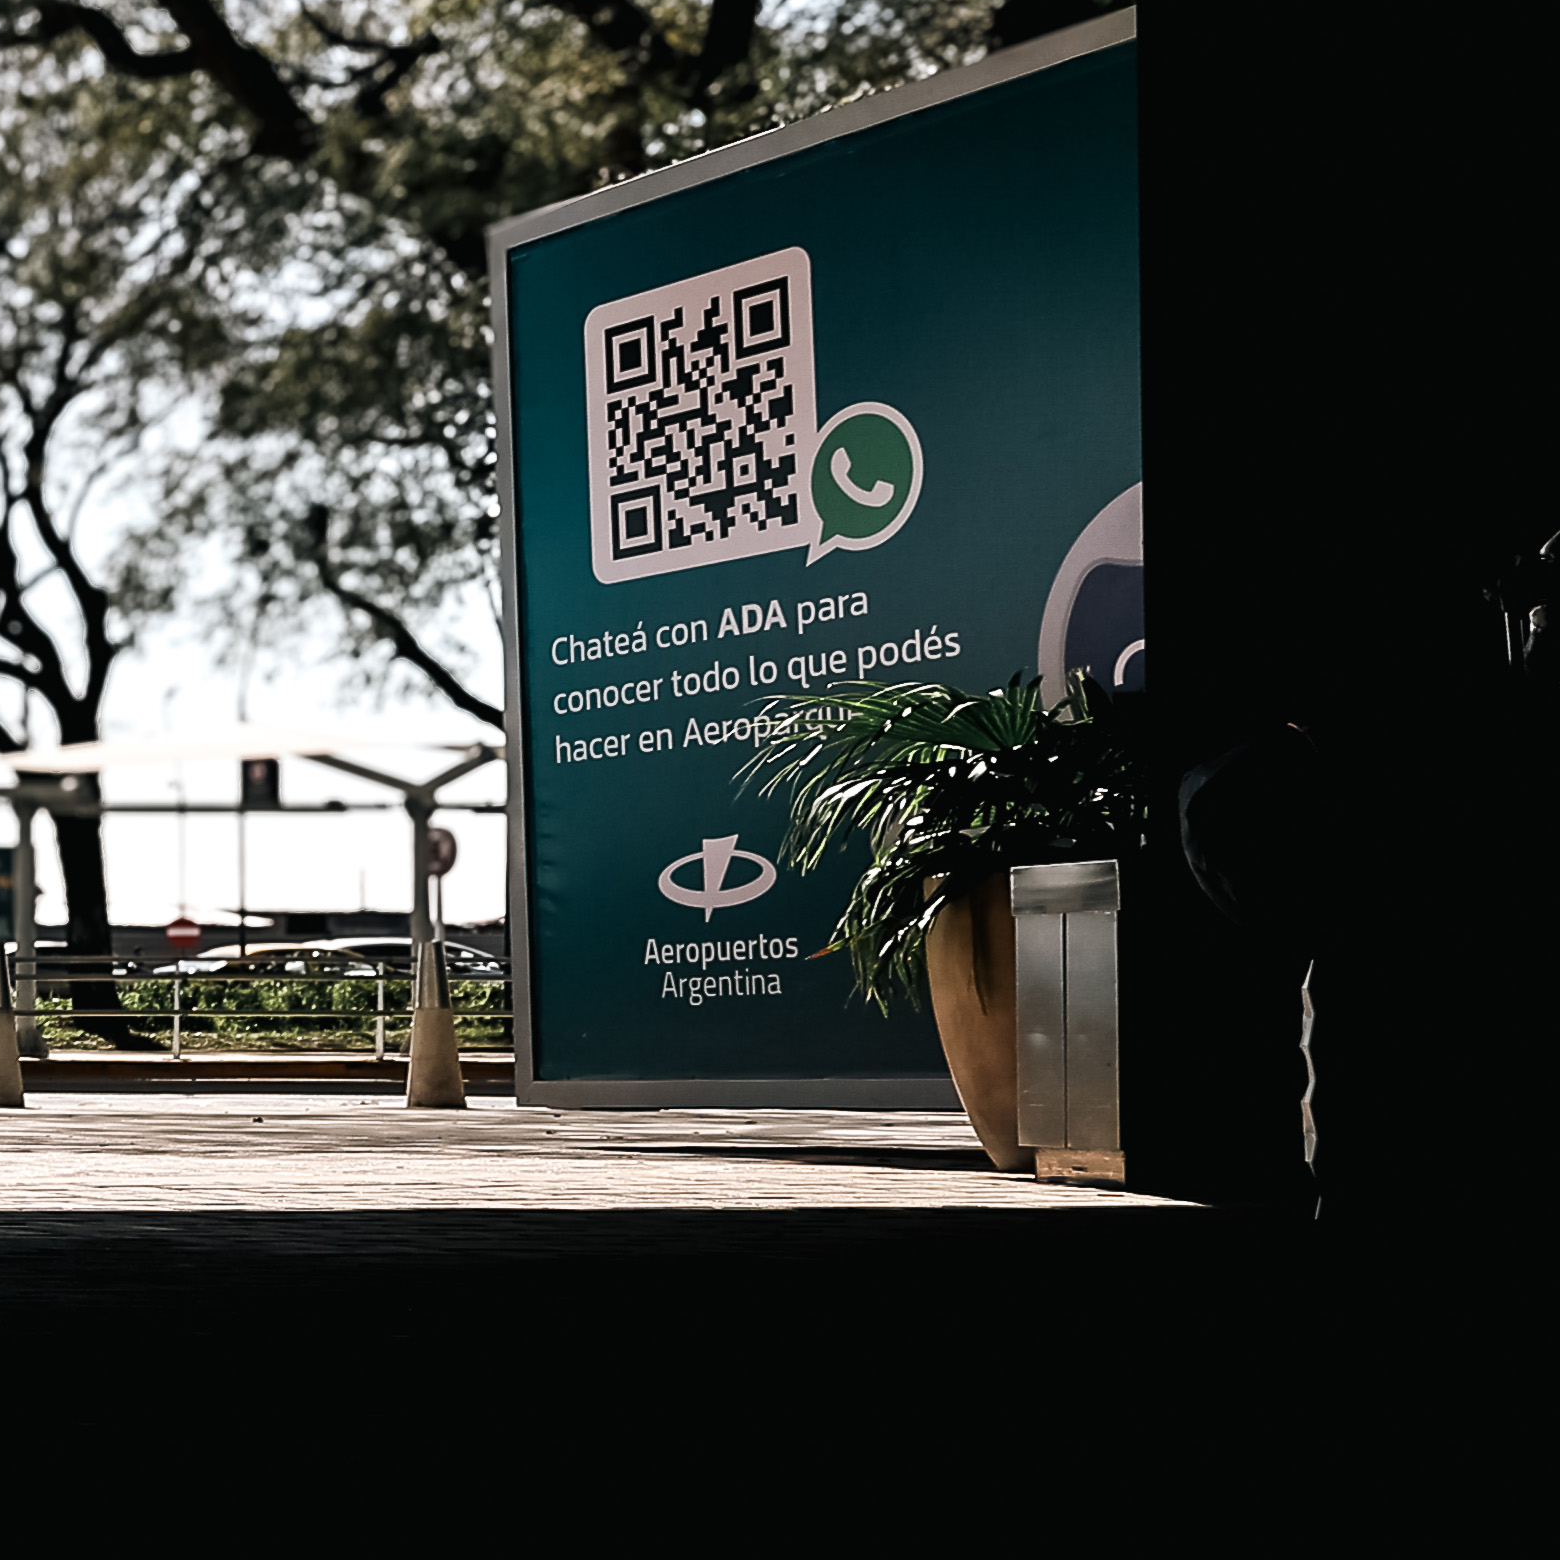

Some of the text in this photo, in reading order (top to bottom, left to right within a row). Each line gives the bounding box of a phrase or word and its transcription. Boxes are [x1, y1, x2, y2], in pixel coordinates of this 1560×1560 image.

[551, 591, 869, 666] Chateá con ADA para
[552, 624, 962, 715] conocer todo lo que podés
[554, 734, 631, 764] hacer
[638, 726, 675, 753] en
[644, 933, 799, 971] Aeropuertos
[661, 968, 783, 1006] Argentina
